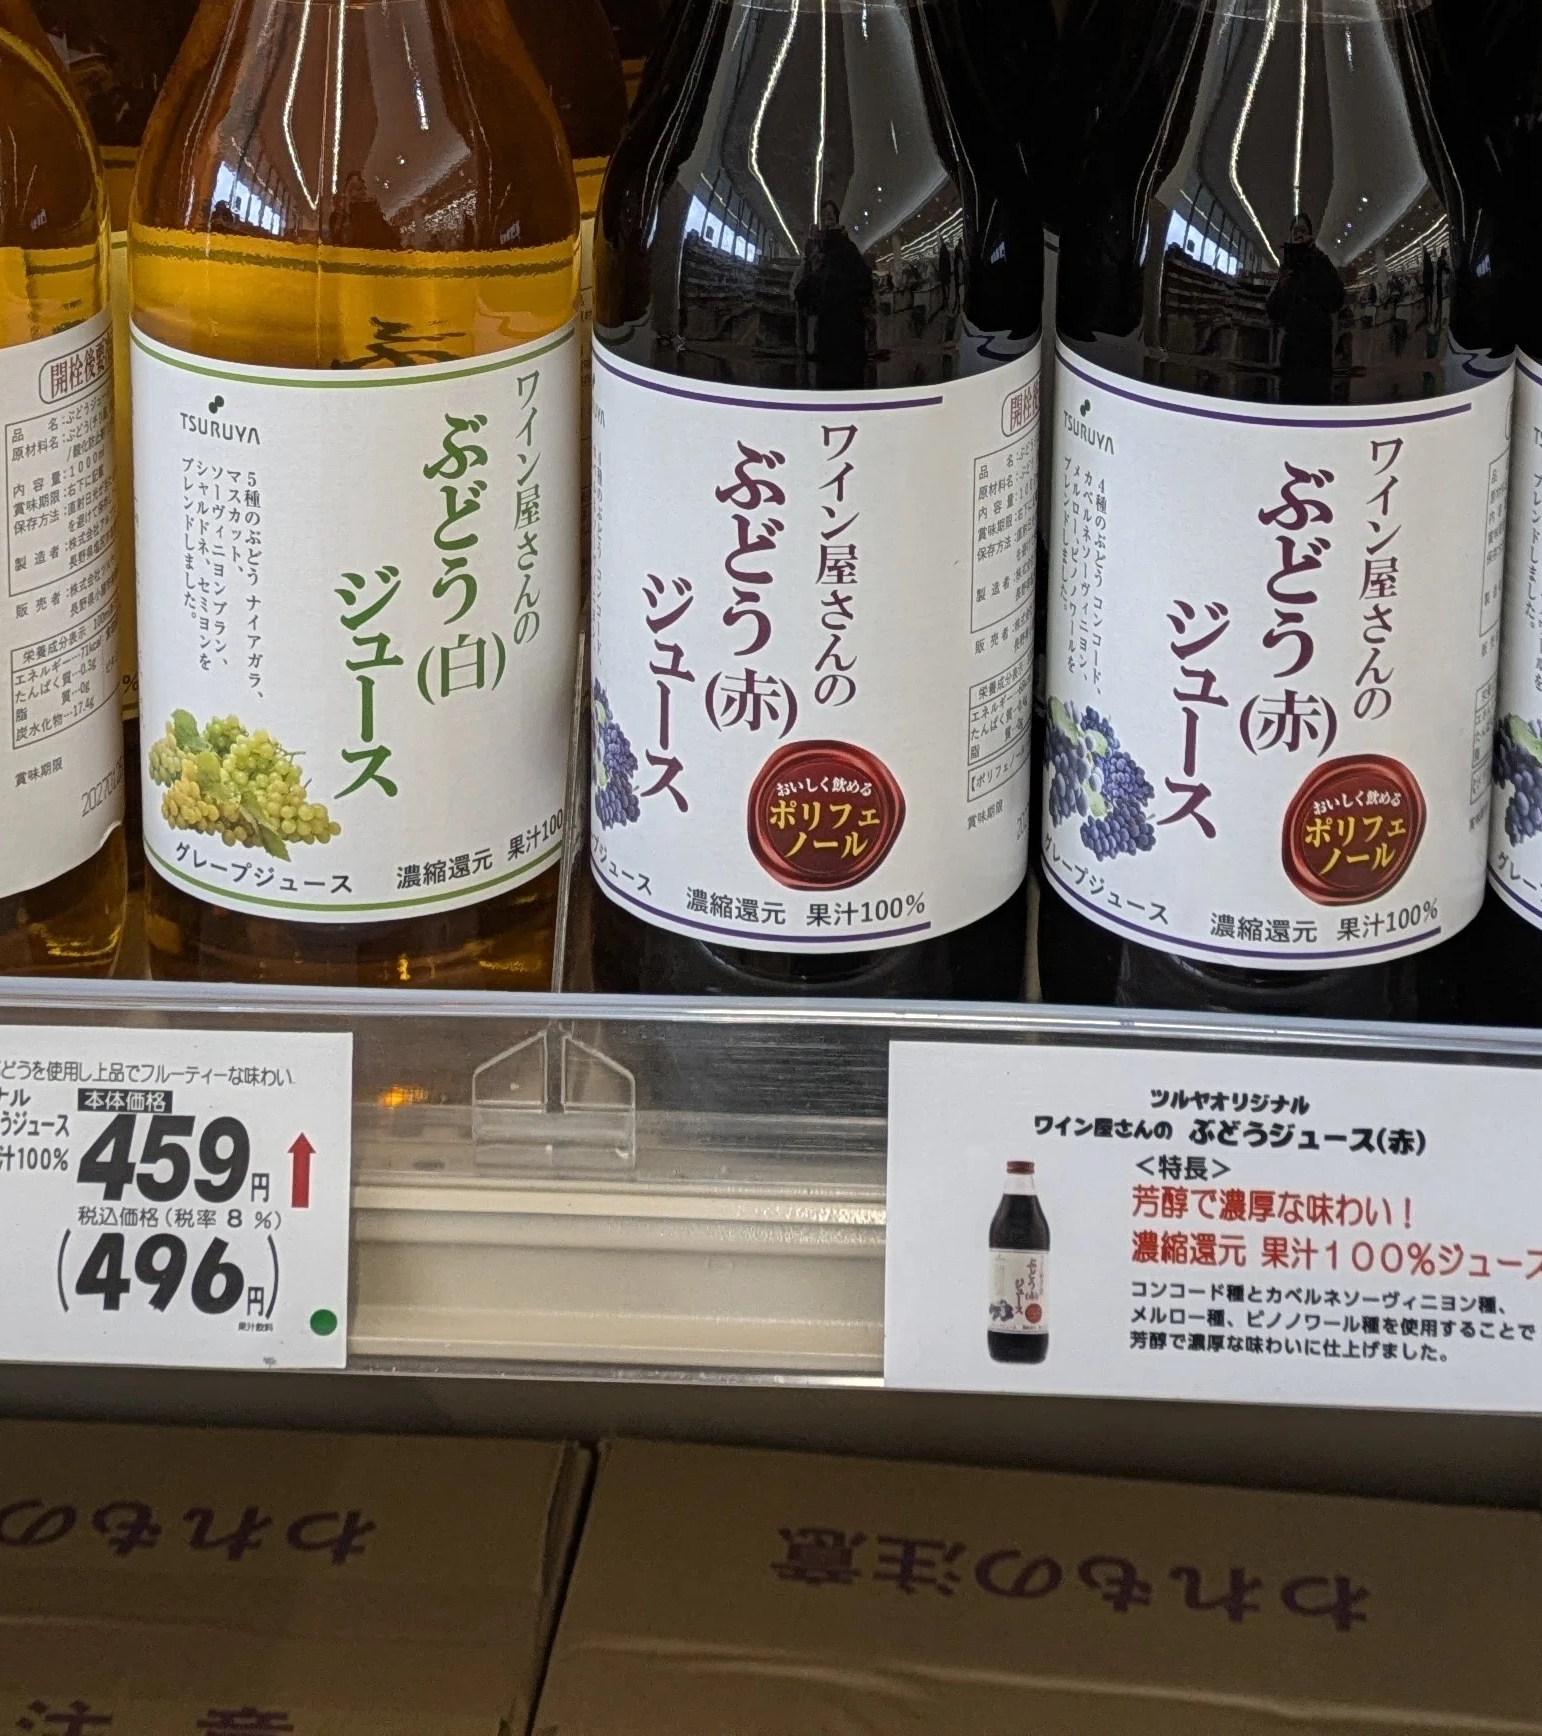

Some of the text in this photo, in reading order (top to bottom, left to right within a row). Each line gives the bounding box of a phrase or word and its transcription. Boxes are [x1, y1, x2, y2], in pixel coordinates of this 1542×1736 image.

[180, 411, 261, 446] TSURUYA
[181, 457, 198, 622] ブレンドしました。
[227, 468, 245, 573] マスカット、
[243, 470, 262, 588] 5種のぶどう
[813, 424, 861, 708] ワイン屋さんの
[640, 573, 695, 814] ジュース
[775, 775, 873, 798] おいしく飲める
[1313, 789, 1403, 818] おいしく飲める
[175, 842, 354, 896] グレープジュース
[685, 886, 927, 928] 濃縮還元 果汁100%
[1209, 898, 1439, 944] 濃縮還元 果汁100%
[85, 1090, 167, 1112] 本体価格
[1150, 1088, 1310, 1117] ツルヤオリジナル
[1034, 1115, 1173, 1142] ワイン屋さんの
[1130, 1231, 1246, 1269] 濃縮還元
[1129, 1331, 1451, 1364] 芳醇で濃厚な味わいに仕上げました。
[772, 1525, 1371, 1633] われもの注意
